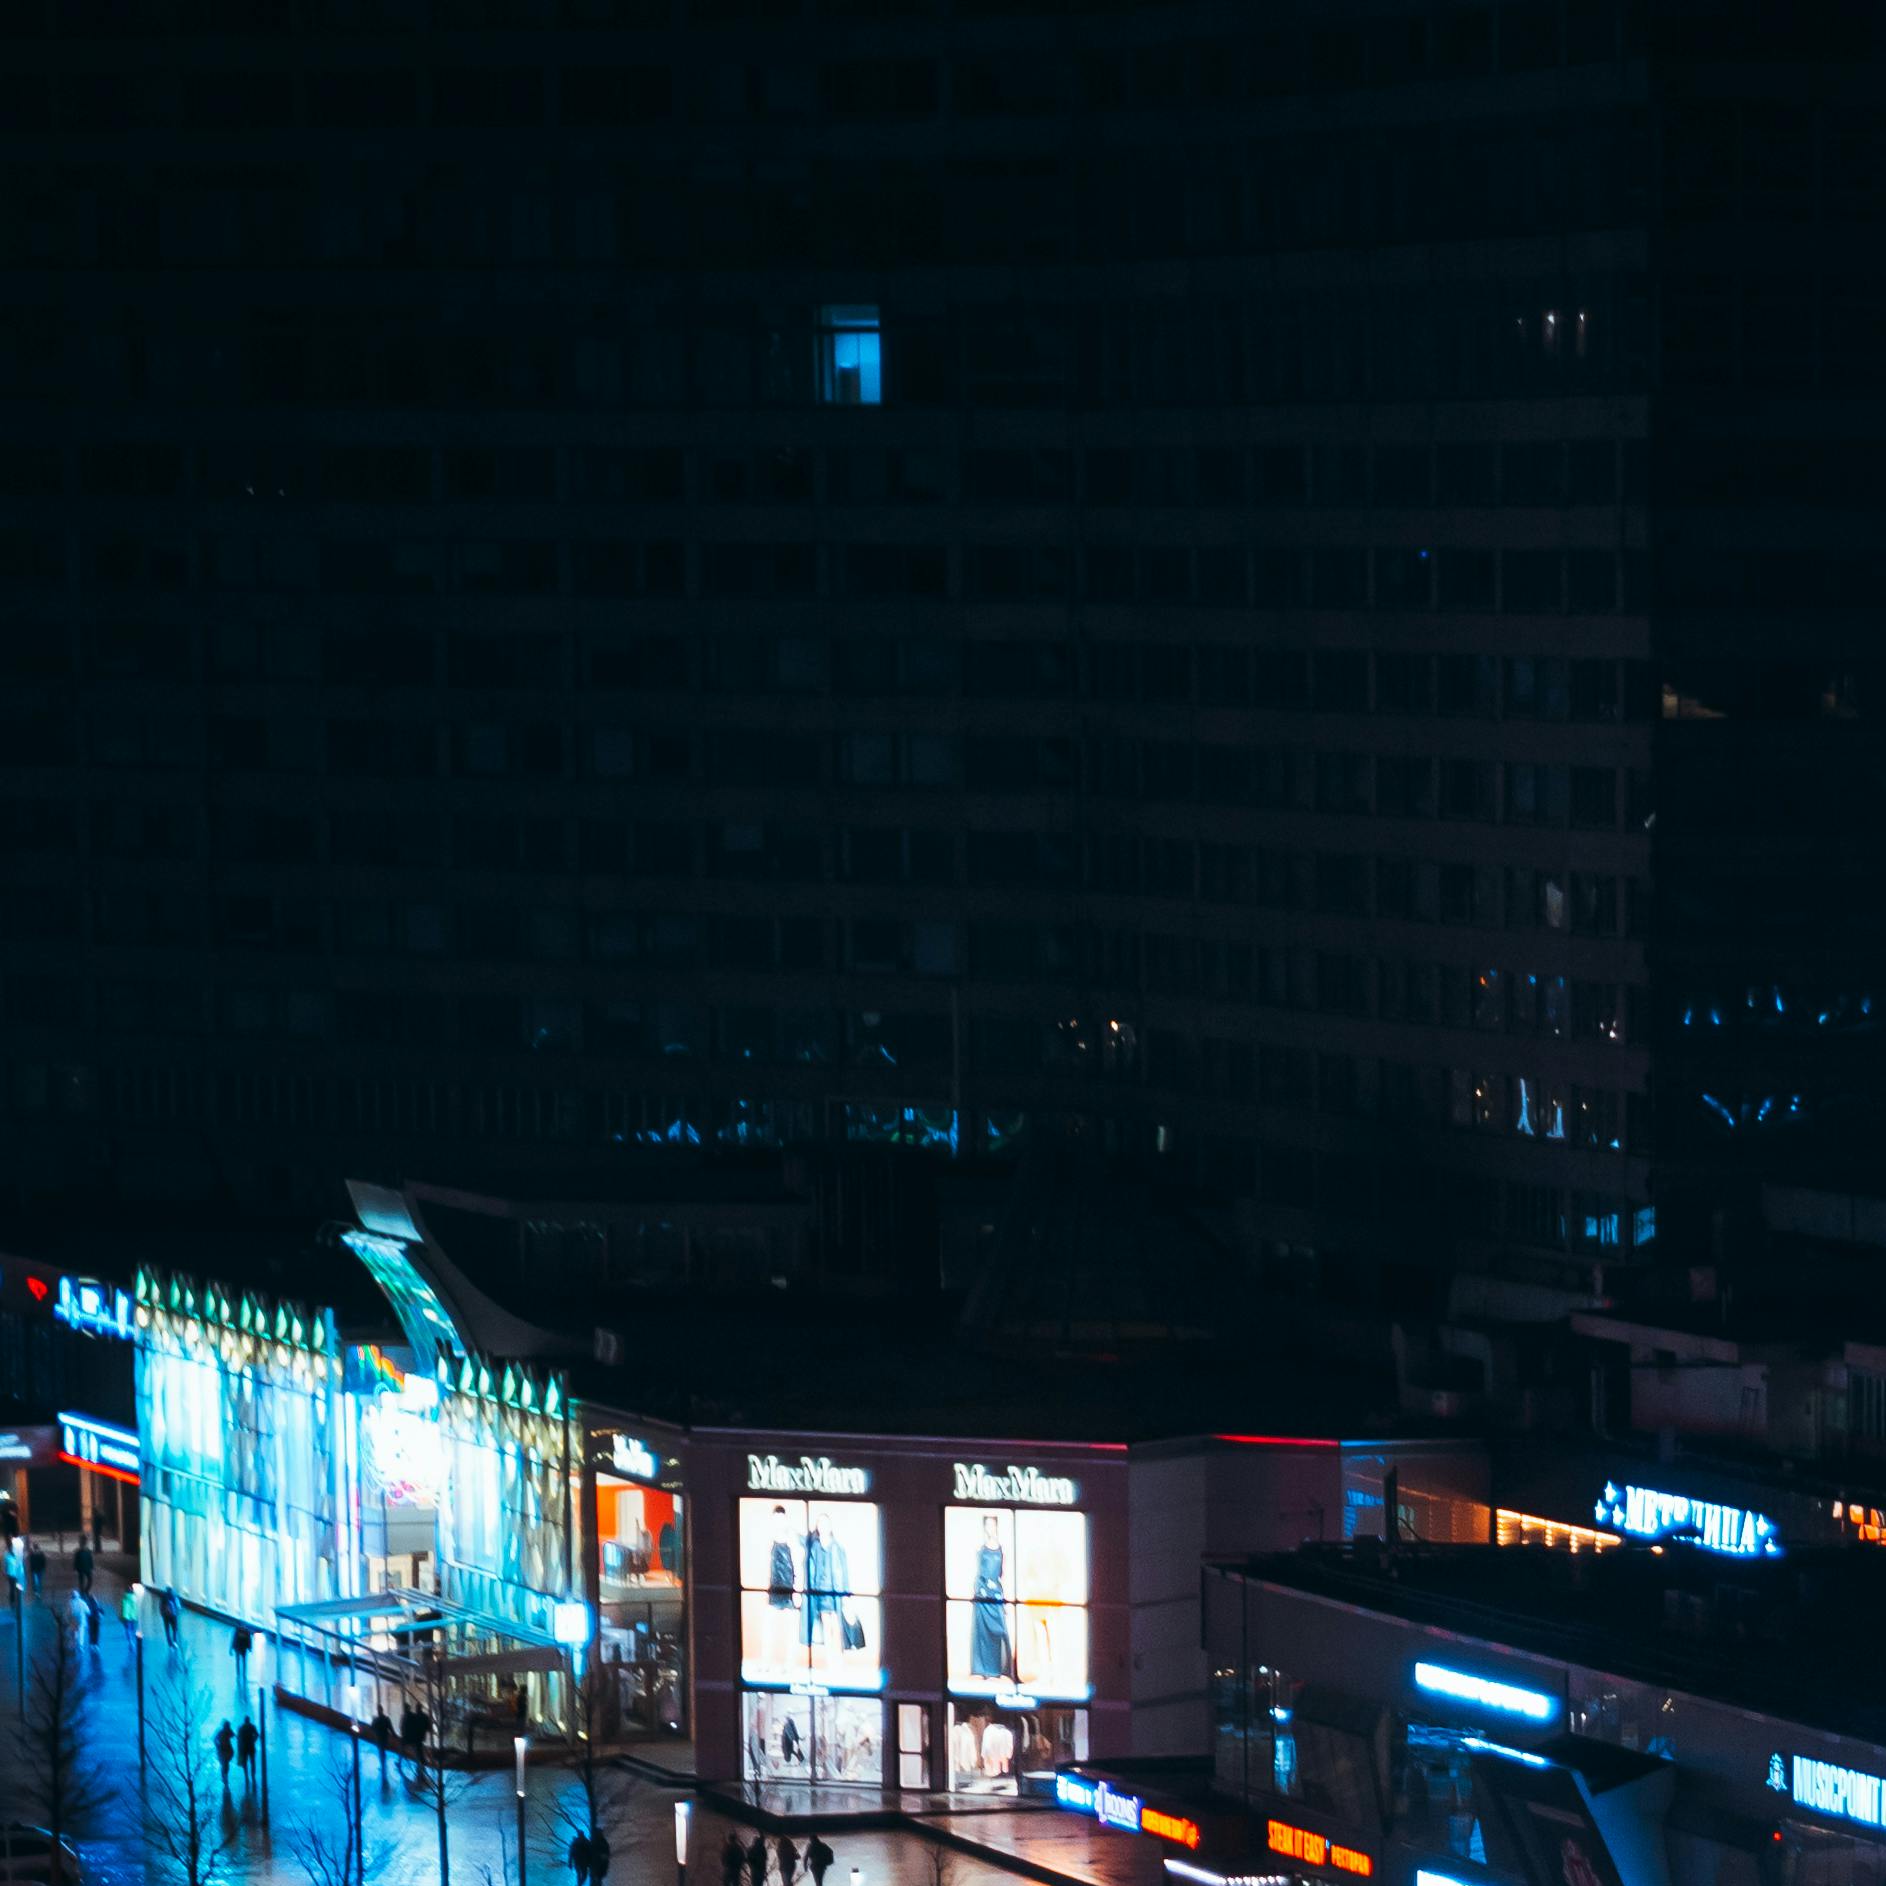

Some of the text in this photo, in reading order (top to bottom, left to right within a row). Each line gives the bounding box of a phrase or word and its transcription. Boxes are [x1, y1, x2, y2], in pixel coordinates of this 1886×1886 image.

[748, 1454, 867, 1494] MaxMara
[954, 1463, 1075, 1504] MaxMara
[1793, 1755, 1880, 1824] MUSICPOINT
